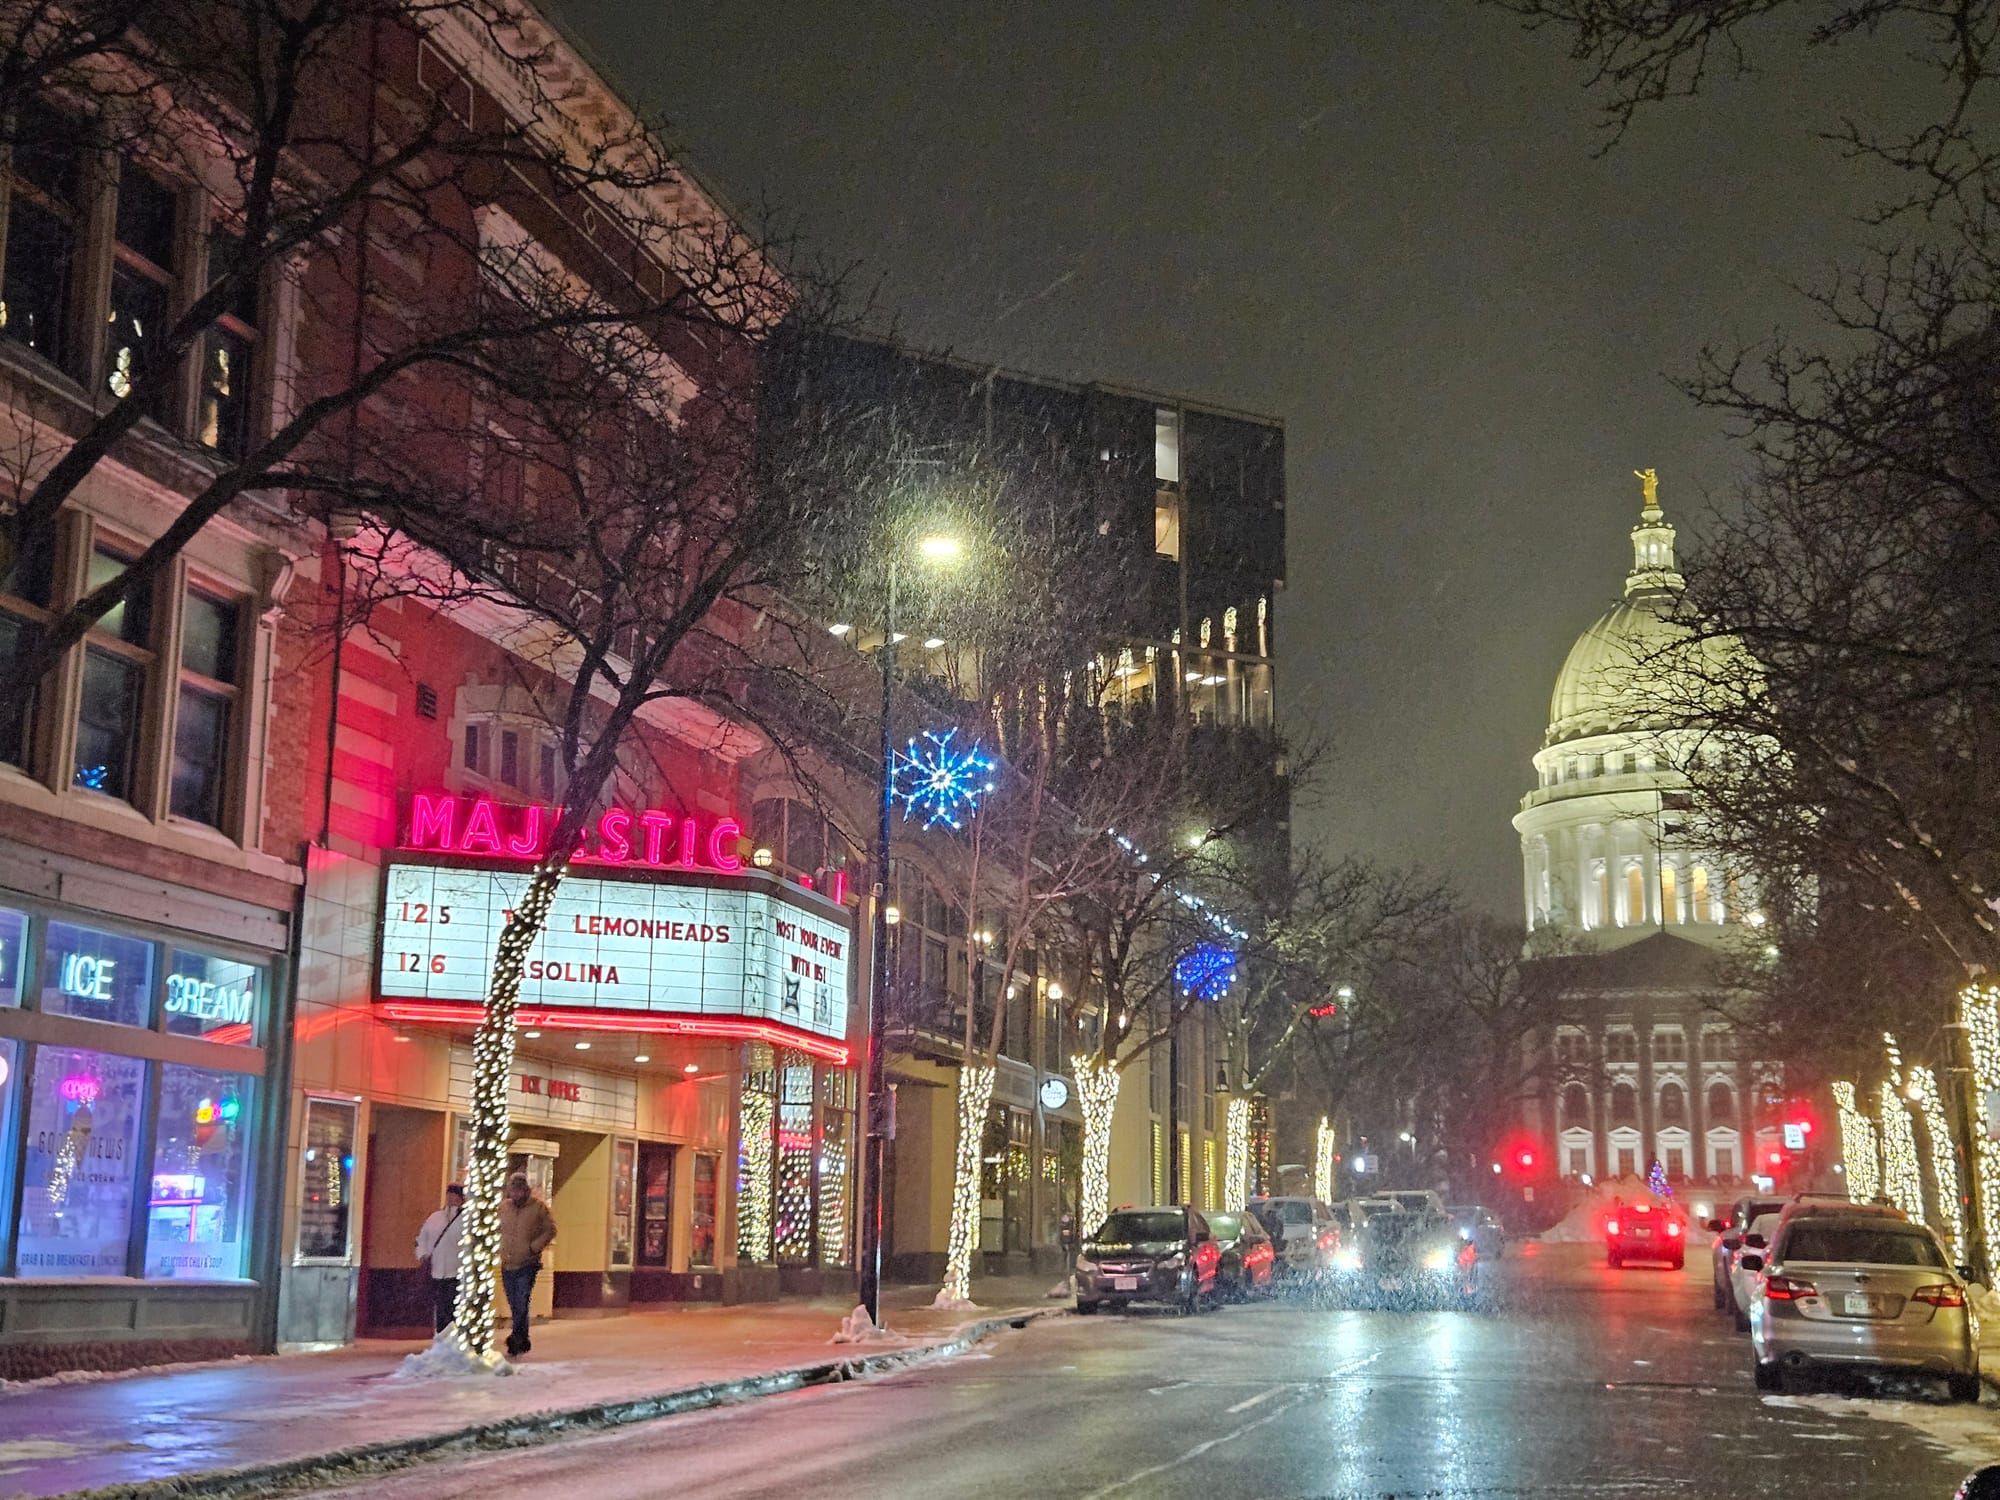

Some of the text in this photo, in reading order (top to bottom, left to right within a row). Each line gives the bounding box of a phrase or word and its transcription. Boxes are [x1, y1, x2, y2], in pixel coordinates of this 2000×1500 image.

[412, 793, 741, 871] MAJSTIC
[574, 914, 731, 943] LEMONHEADS
[776, 918, 842, 960] HOST YOUR EVENT
[63, 953, 116, 1001] ICE
[516, 960, 620, 984] SOLINA
[791, 954, 810, 978] WITH
[164, 973, 254, 1024] CREAM
